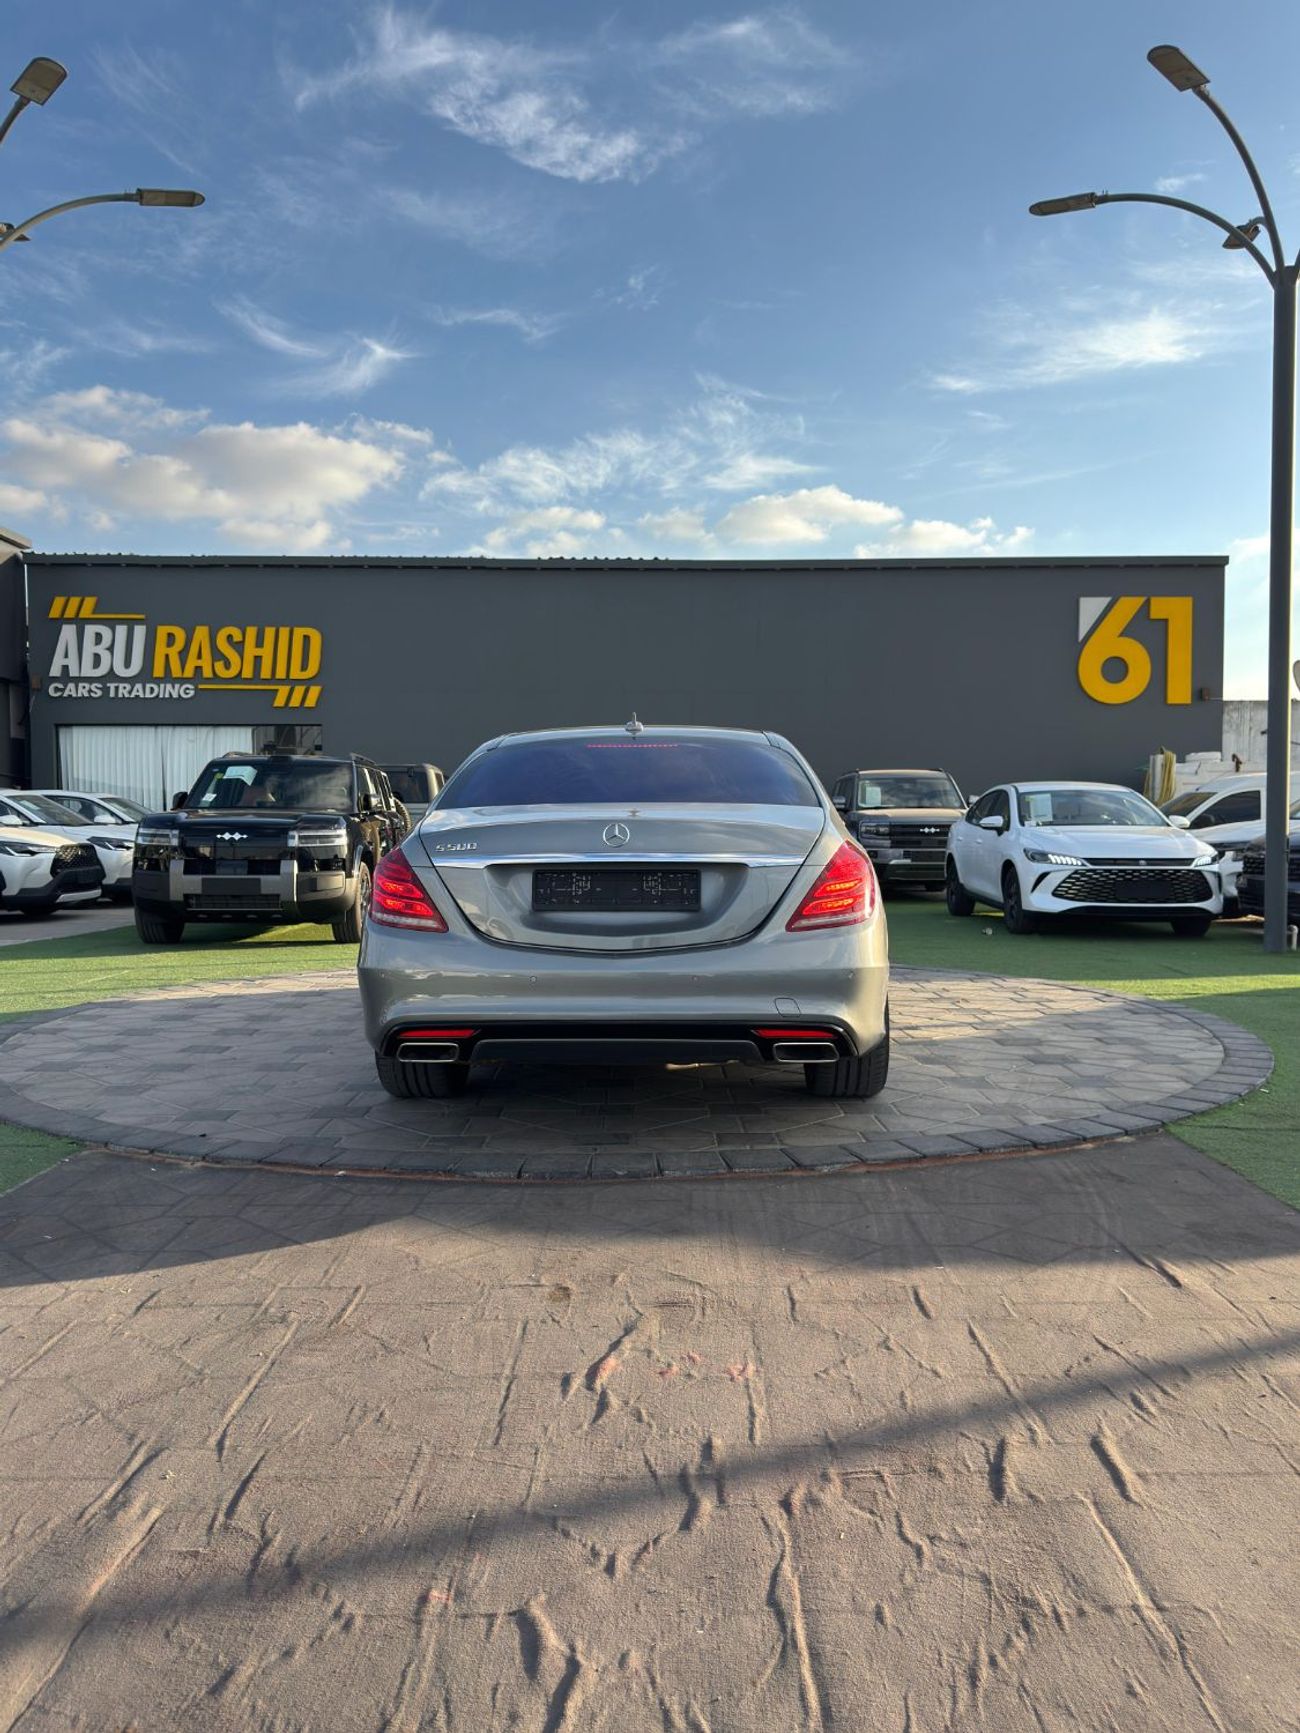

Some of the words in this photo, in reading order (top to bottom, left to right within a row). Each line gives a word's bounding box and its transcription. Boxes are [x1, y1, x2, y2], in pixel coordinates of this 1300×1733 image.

[48, 624, 147, 678] ABU
[152, 625, 322, 680] RASHID
[1078, 596, 1193, 705] 61
[48, 682, 103, 698] CARS
[107, 683, 195, 699] TRADING
